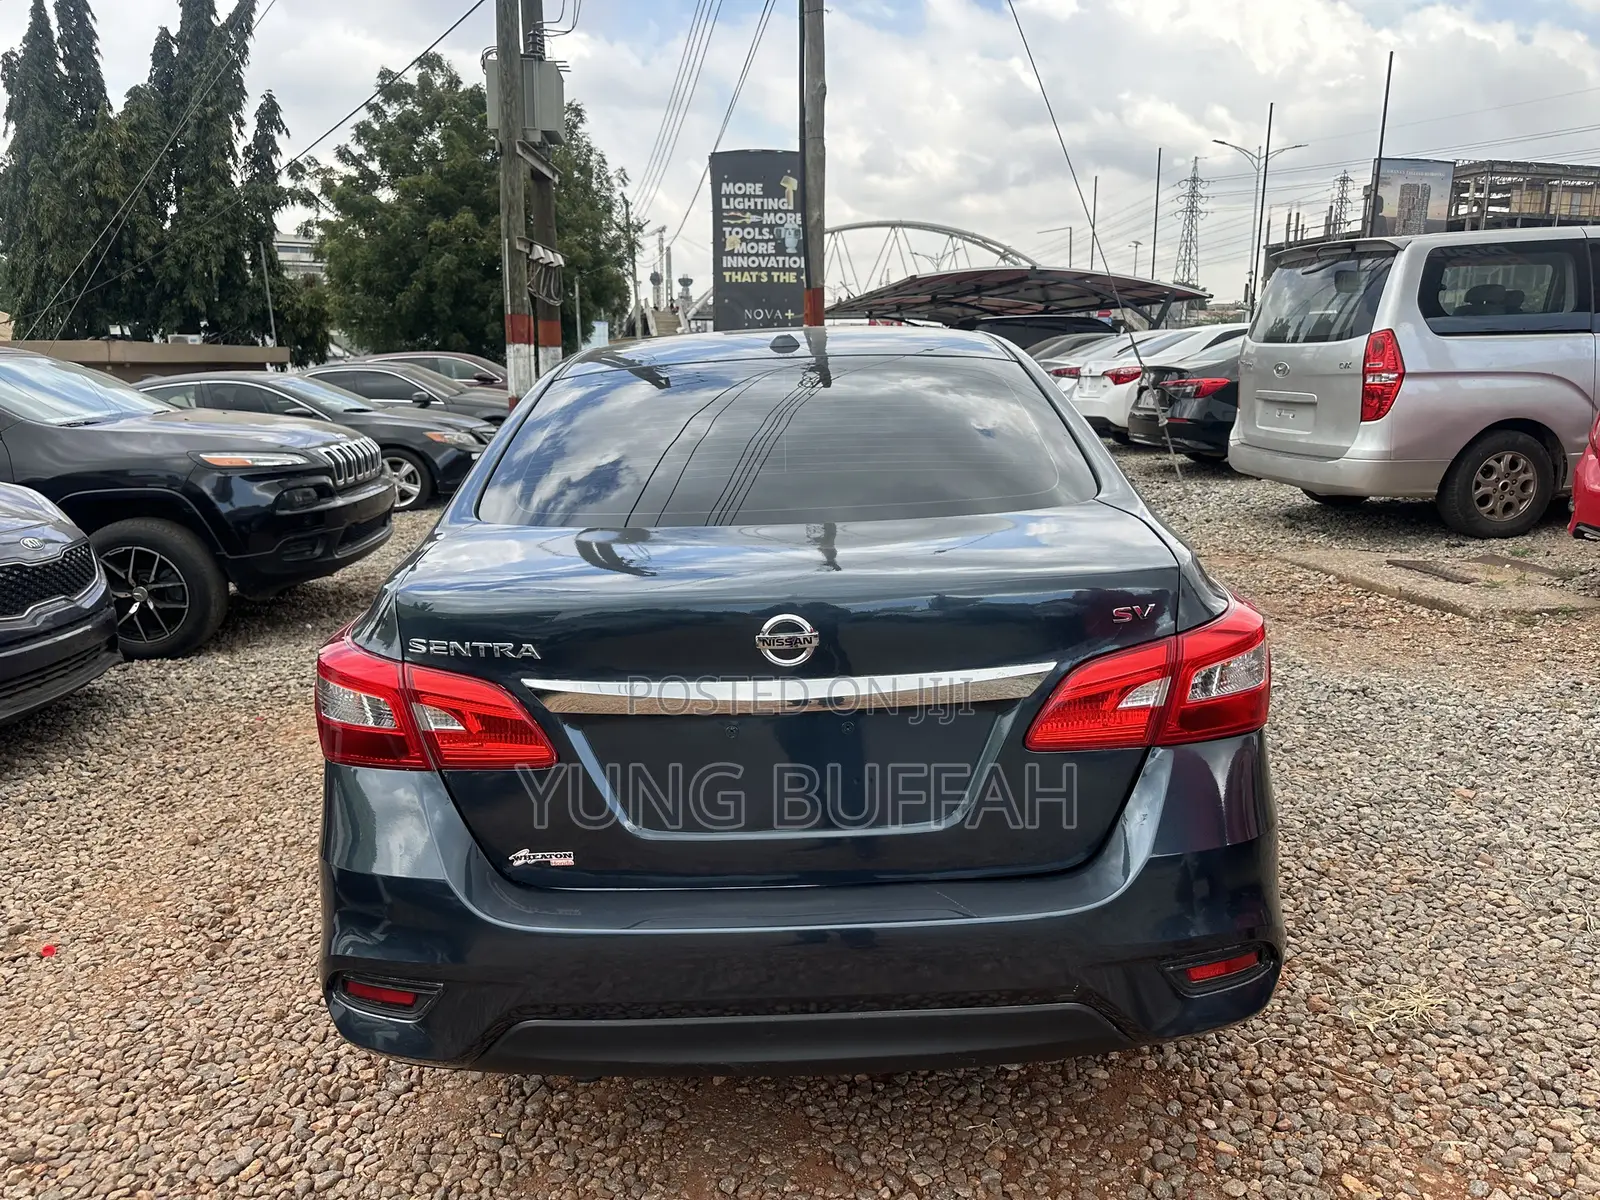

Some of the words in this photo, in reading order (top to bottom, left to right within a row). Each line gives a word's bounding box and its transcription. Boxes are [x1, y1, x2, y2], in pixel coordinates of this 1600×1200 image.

[721, 182, 763, 195] MORE
[762, 212, 802, 225] MORE
[722, 227, 774, 240] TOOLS.
[734, 242, 776, 254] MORE
[723, 271, 768, 283] THAT'S
[771, 271, 797, 283] THE
[1112, 603, 1156, 623] SV
[761, 636, 813, 647] NISSAN
[408, 637, 542, 660] SENTRA
[513, 853, 573, 862] WHEATON
